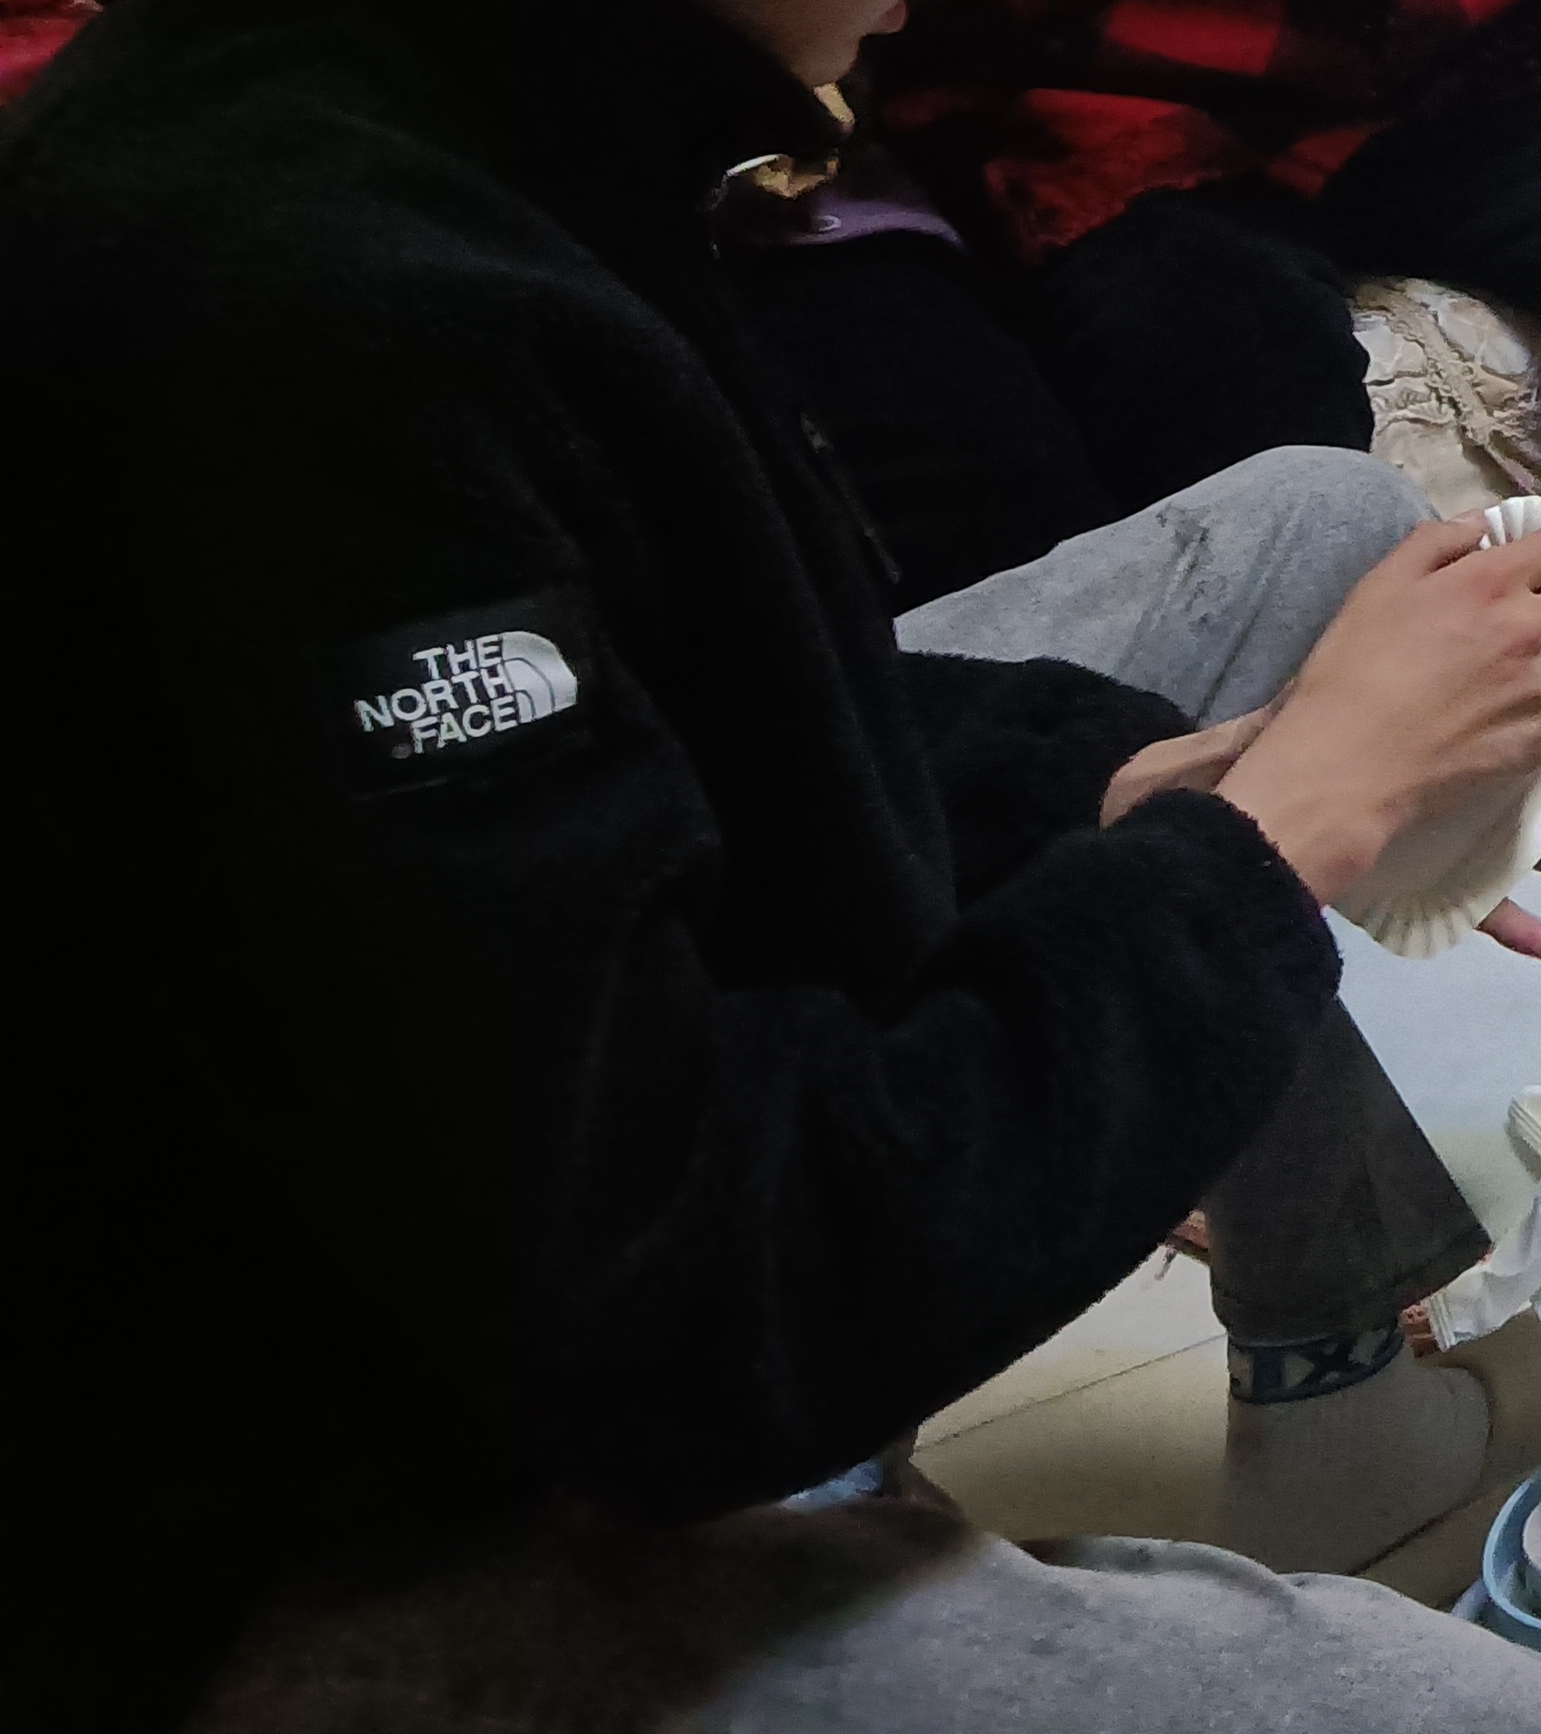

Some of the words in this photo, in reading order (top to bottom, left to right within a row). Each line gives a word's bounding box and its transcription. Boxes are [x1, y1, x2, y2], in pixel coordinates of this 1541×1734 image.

[412, 634, 500, 680] THE
[354, 664, 514, 732] NORTH
[410, 695, 519, 755] FACE
